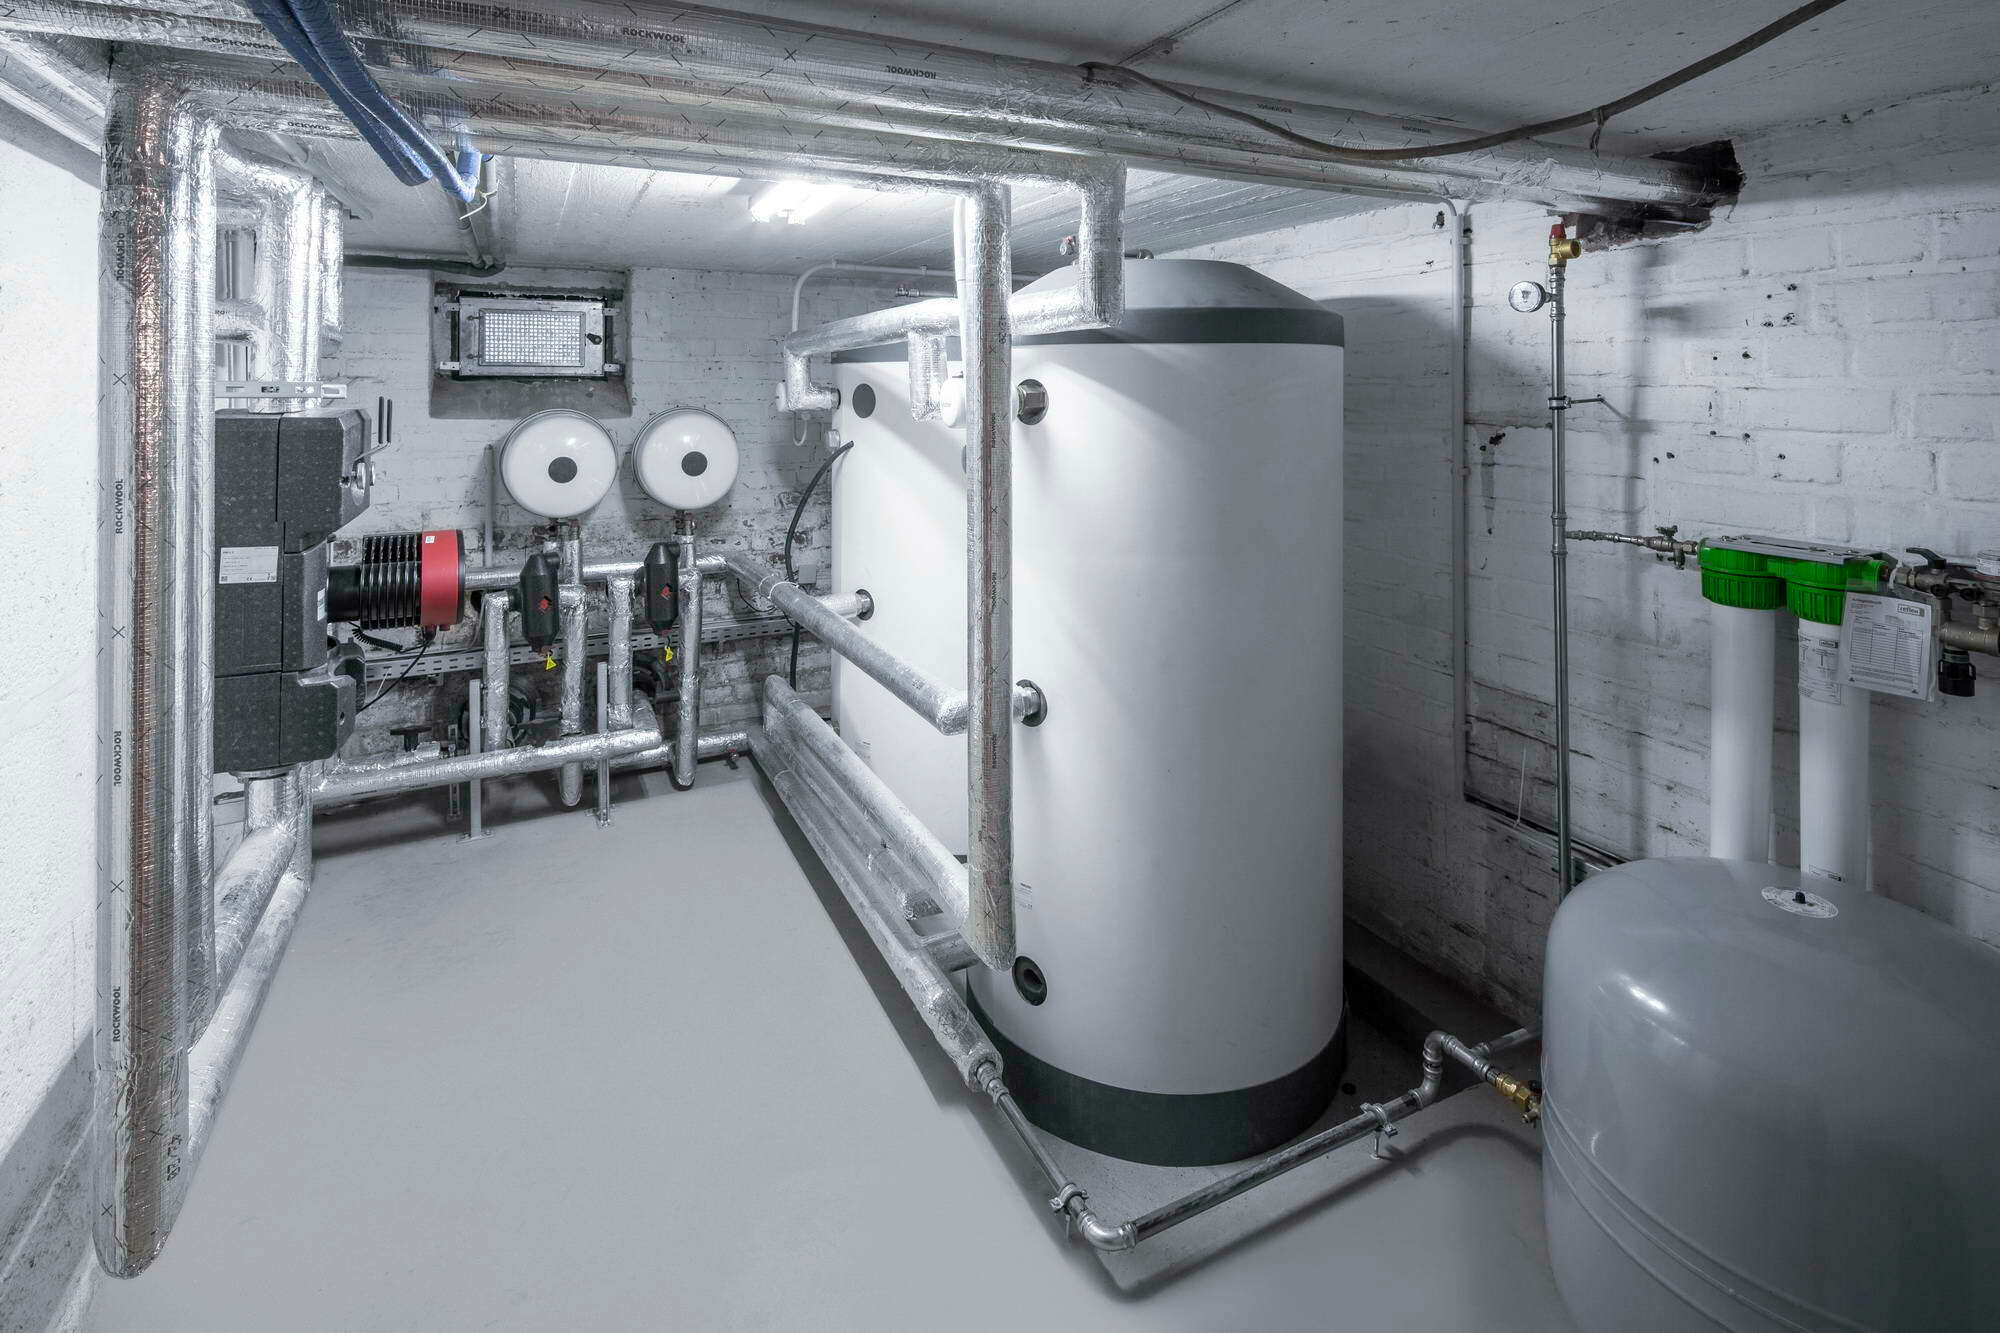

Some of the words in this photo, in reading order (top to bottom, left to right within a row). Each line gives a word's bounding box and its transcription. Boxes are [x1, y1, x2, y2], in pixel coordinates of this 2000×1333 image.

[623, 27, 686, 43] ROCKWOOL
[886, 65, 937, 79] ROCKWOOL
[115, 479, 123, 534] ROCKWOOL
[113, 730, 122, 787] ROCKWOOL
[113, 985, 121, 1042] ROCKWOOL
